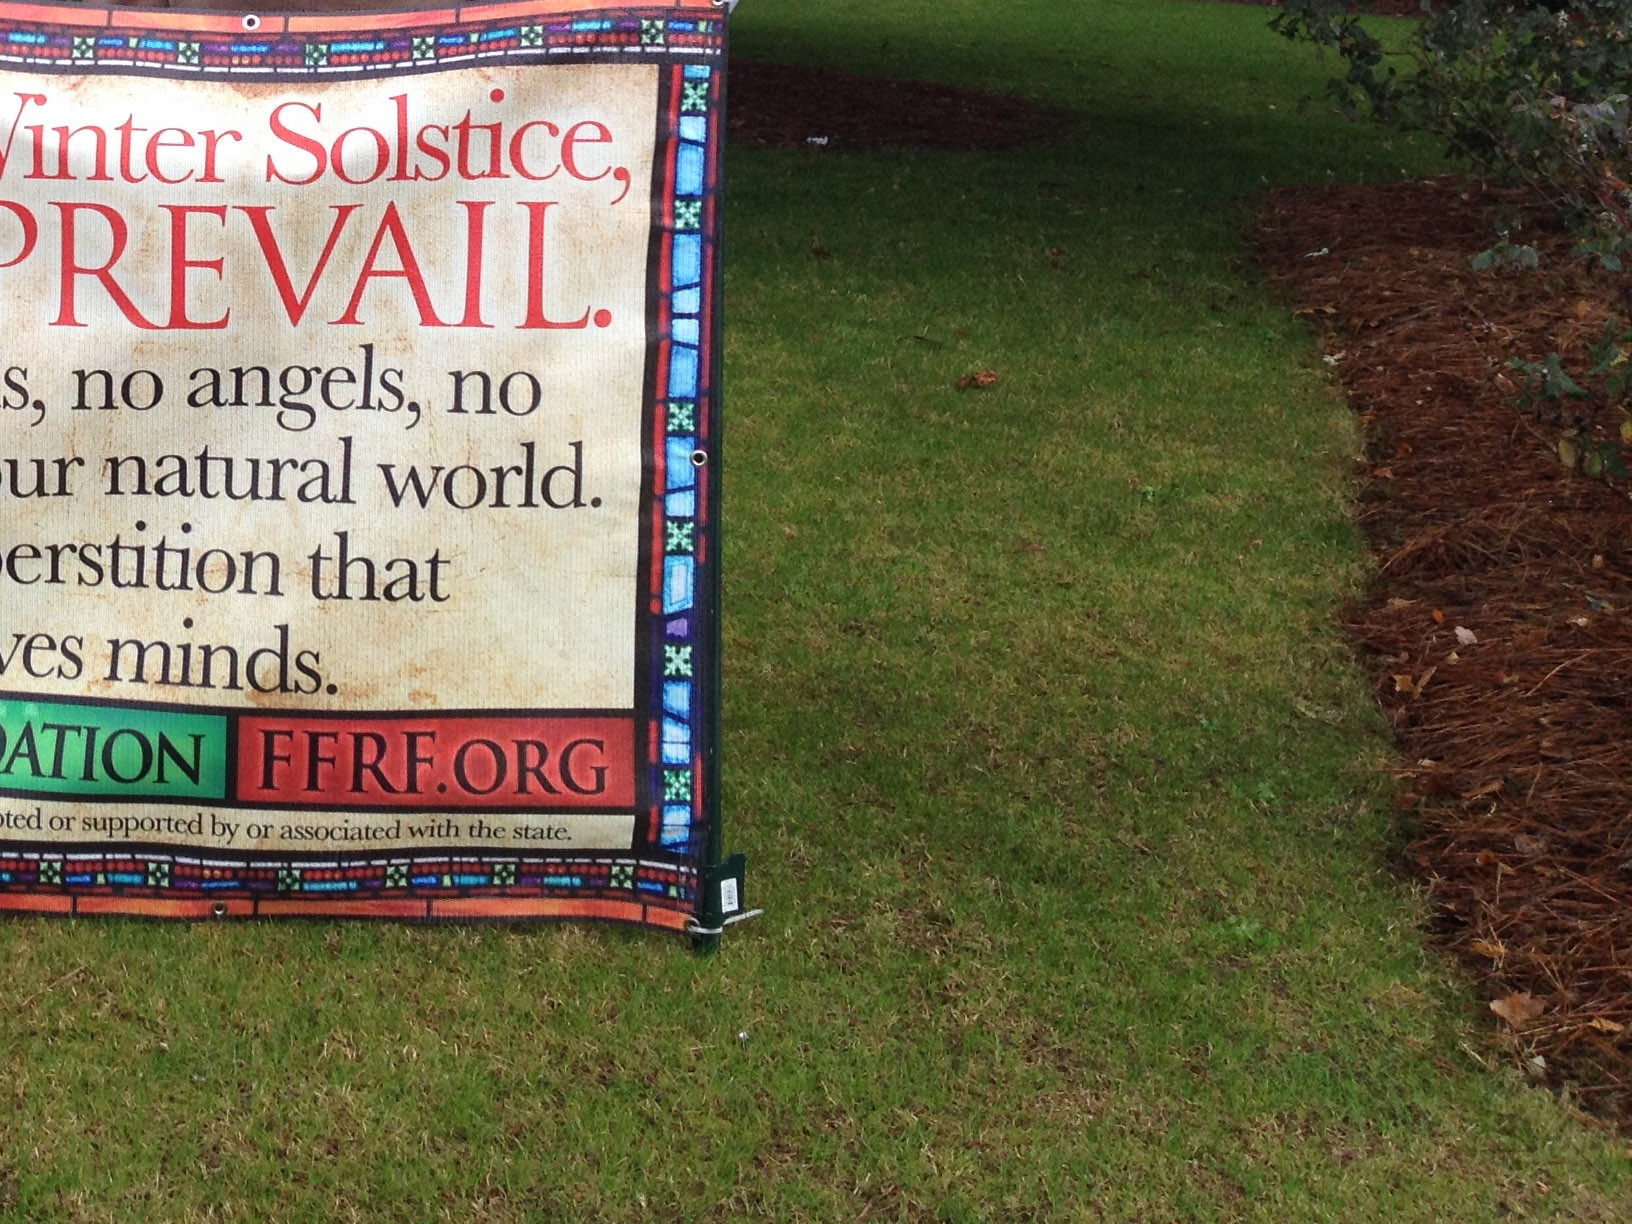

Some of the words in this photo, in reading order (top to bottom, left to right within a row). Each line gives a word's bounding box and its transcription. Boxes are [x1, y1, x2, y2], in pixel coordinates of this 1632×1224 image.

[267, 88, 632, 205] Solstice,
[71, 365, 164, 411] no
[187, 343, 422, 431] angels,
[446, 368, 542, 416] no
[104, 435, 357, 505] natural
[377, 440, 603, 510] world.
[307, 530, 452, 603] that
[106, 617, 338, 696] minds.
[257, 728, 610, 797] FFRF.ORG
[49, 813, 76, 832] or
[81, 813, 203, 838] supported
[210, 814, 240, 840] by
[246, 822, 274, 839] or
[279, 820, 401, 841] associated
[407, 819, 460, 839] with
[468, 819, 506, 839] the
[512, 821, 572, 842] state.
